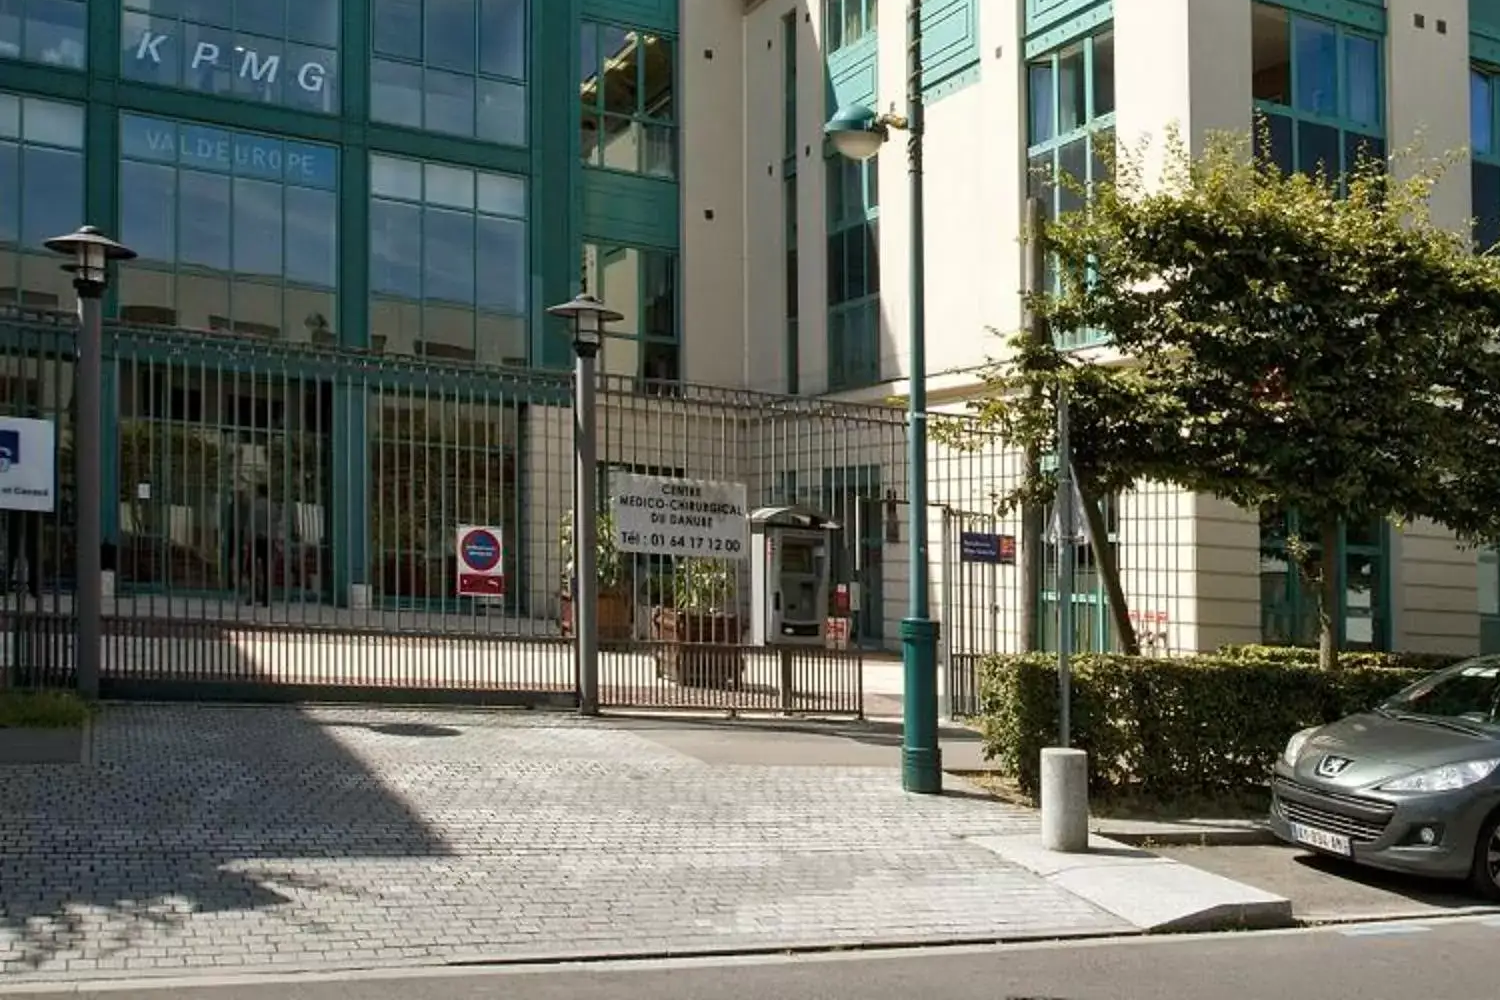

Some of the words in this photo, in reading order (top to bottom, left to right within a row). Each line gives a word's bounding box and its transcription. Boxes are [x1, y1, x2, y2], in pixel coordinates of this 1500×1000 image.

[136, 32, 326, 91] KPMG
[651, 533, 665, 547] 01
[670, 535, 685, 548] 64
[690, 537, 704, 549] 17
[708, 538, 722, 551] 12
[725, 540, 741, 552] 00
